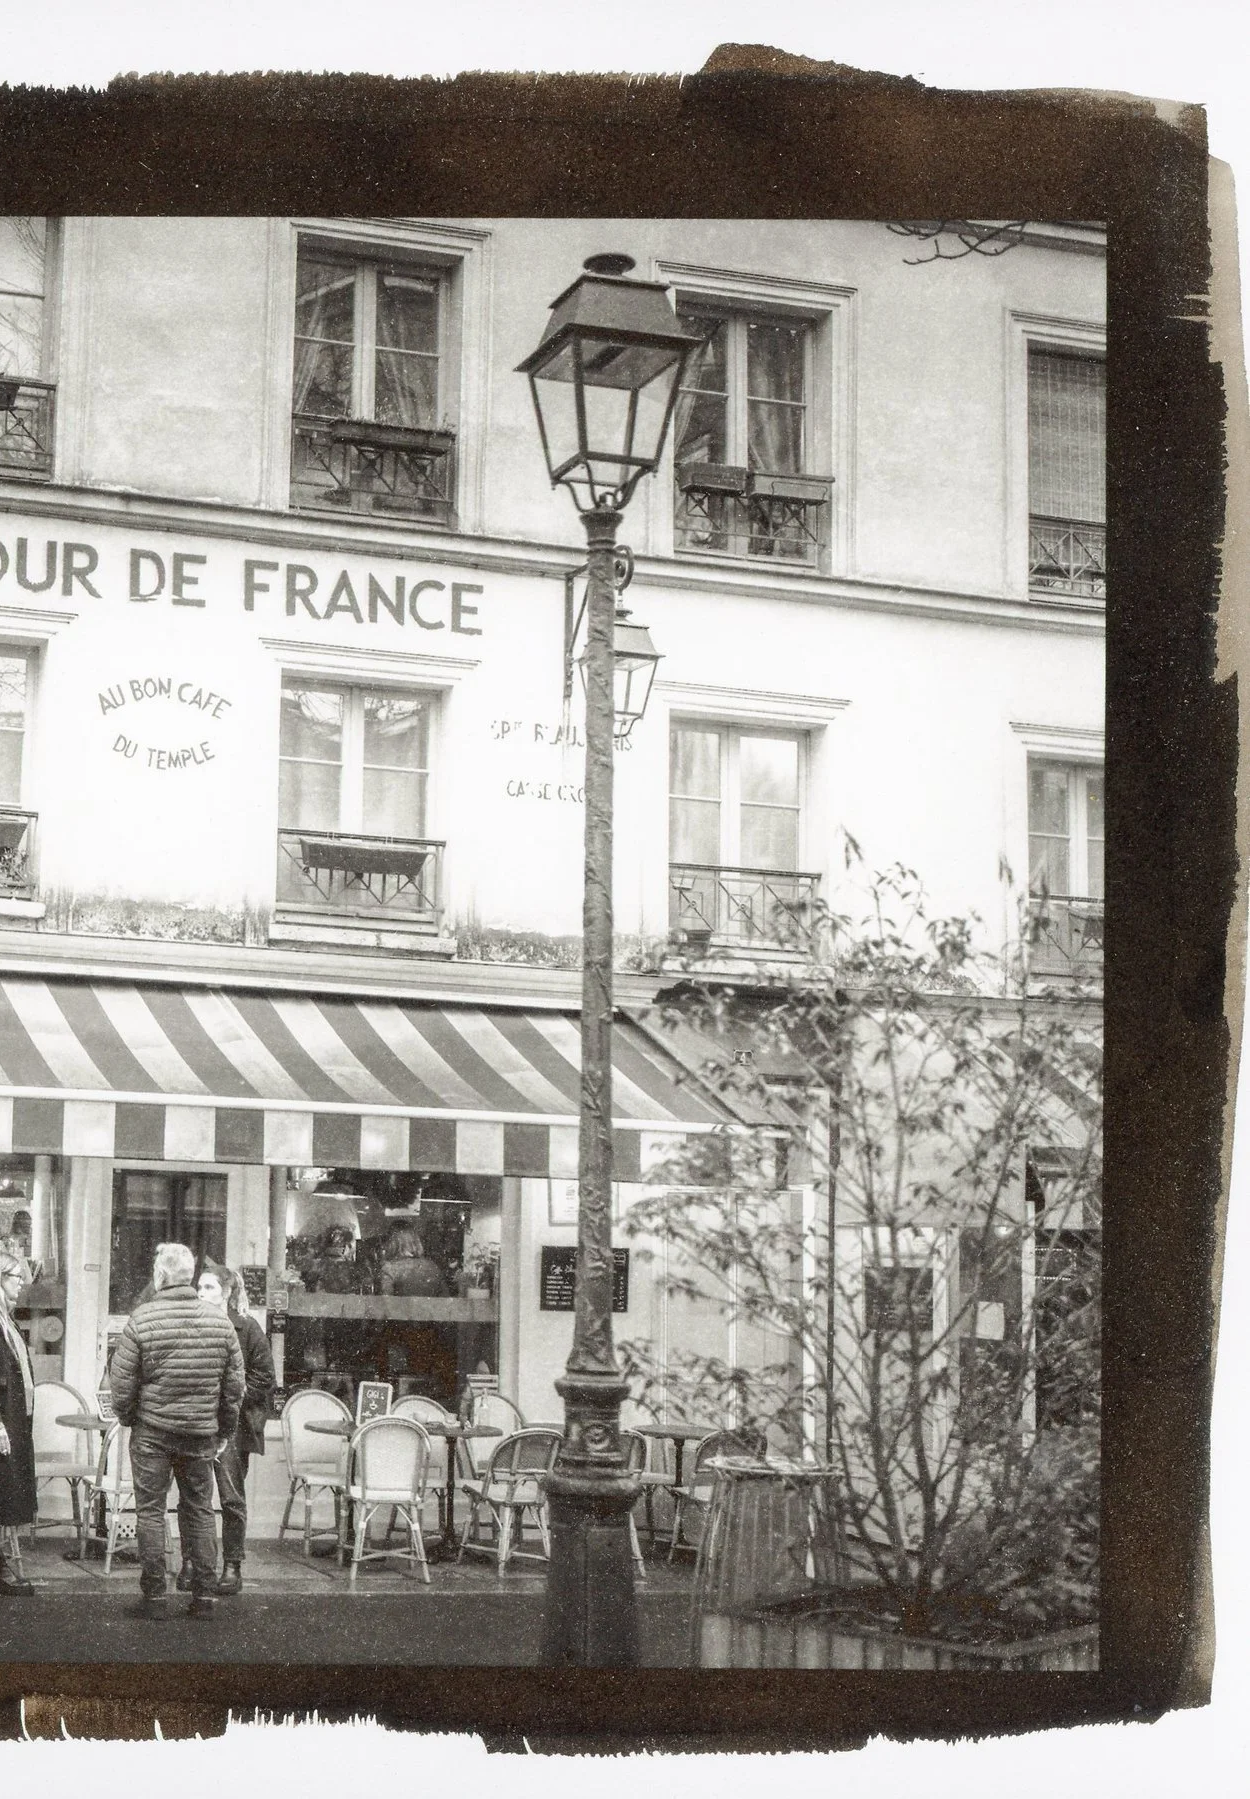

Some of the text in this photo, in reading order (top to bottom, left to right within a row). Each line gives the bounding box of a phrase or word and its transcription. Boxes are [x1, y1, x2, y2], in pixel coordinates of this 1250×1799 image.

[129, 548, 208, 608] DE
[243, 559, 485, 636] FRANCE
[98, 677, 233, 720] AU BON CAFE
[112, 733, 216, 771] DU TEMPLE
